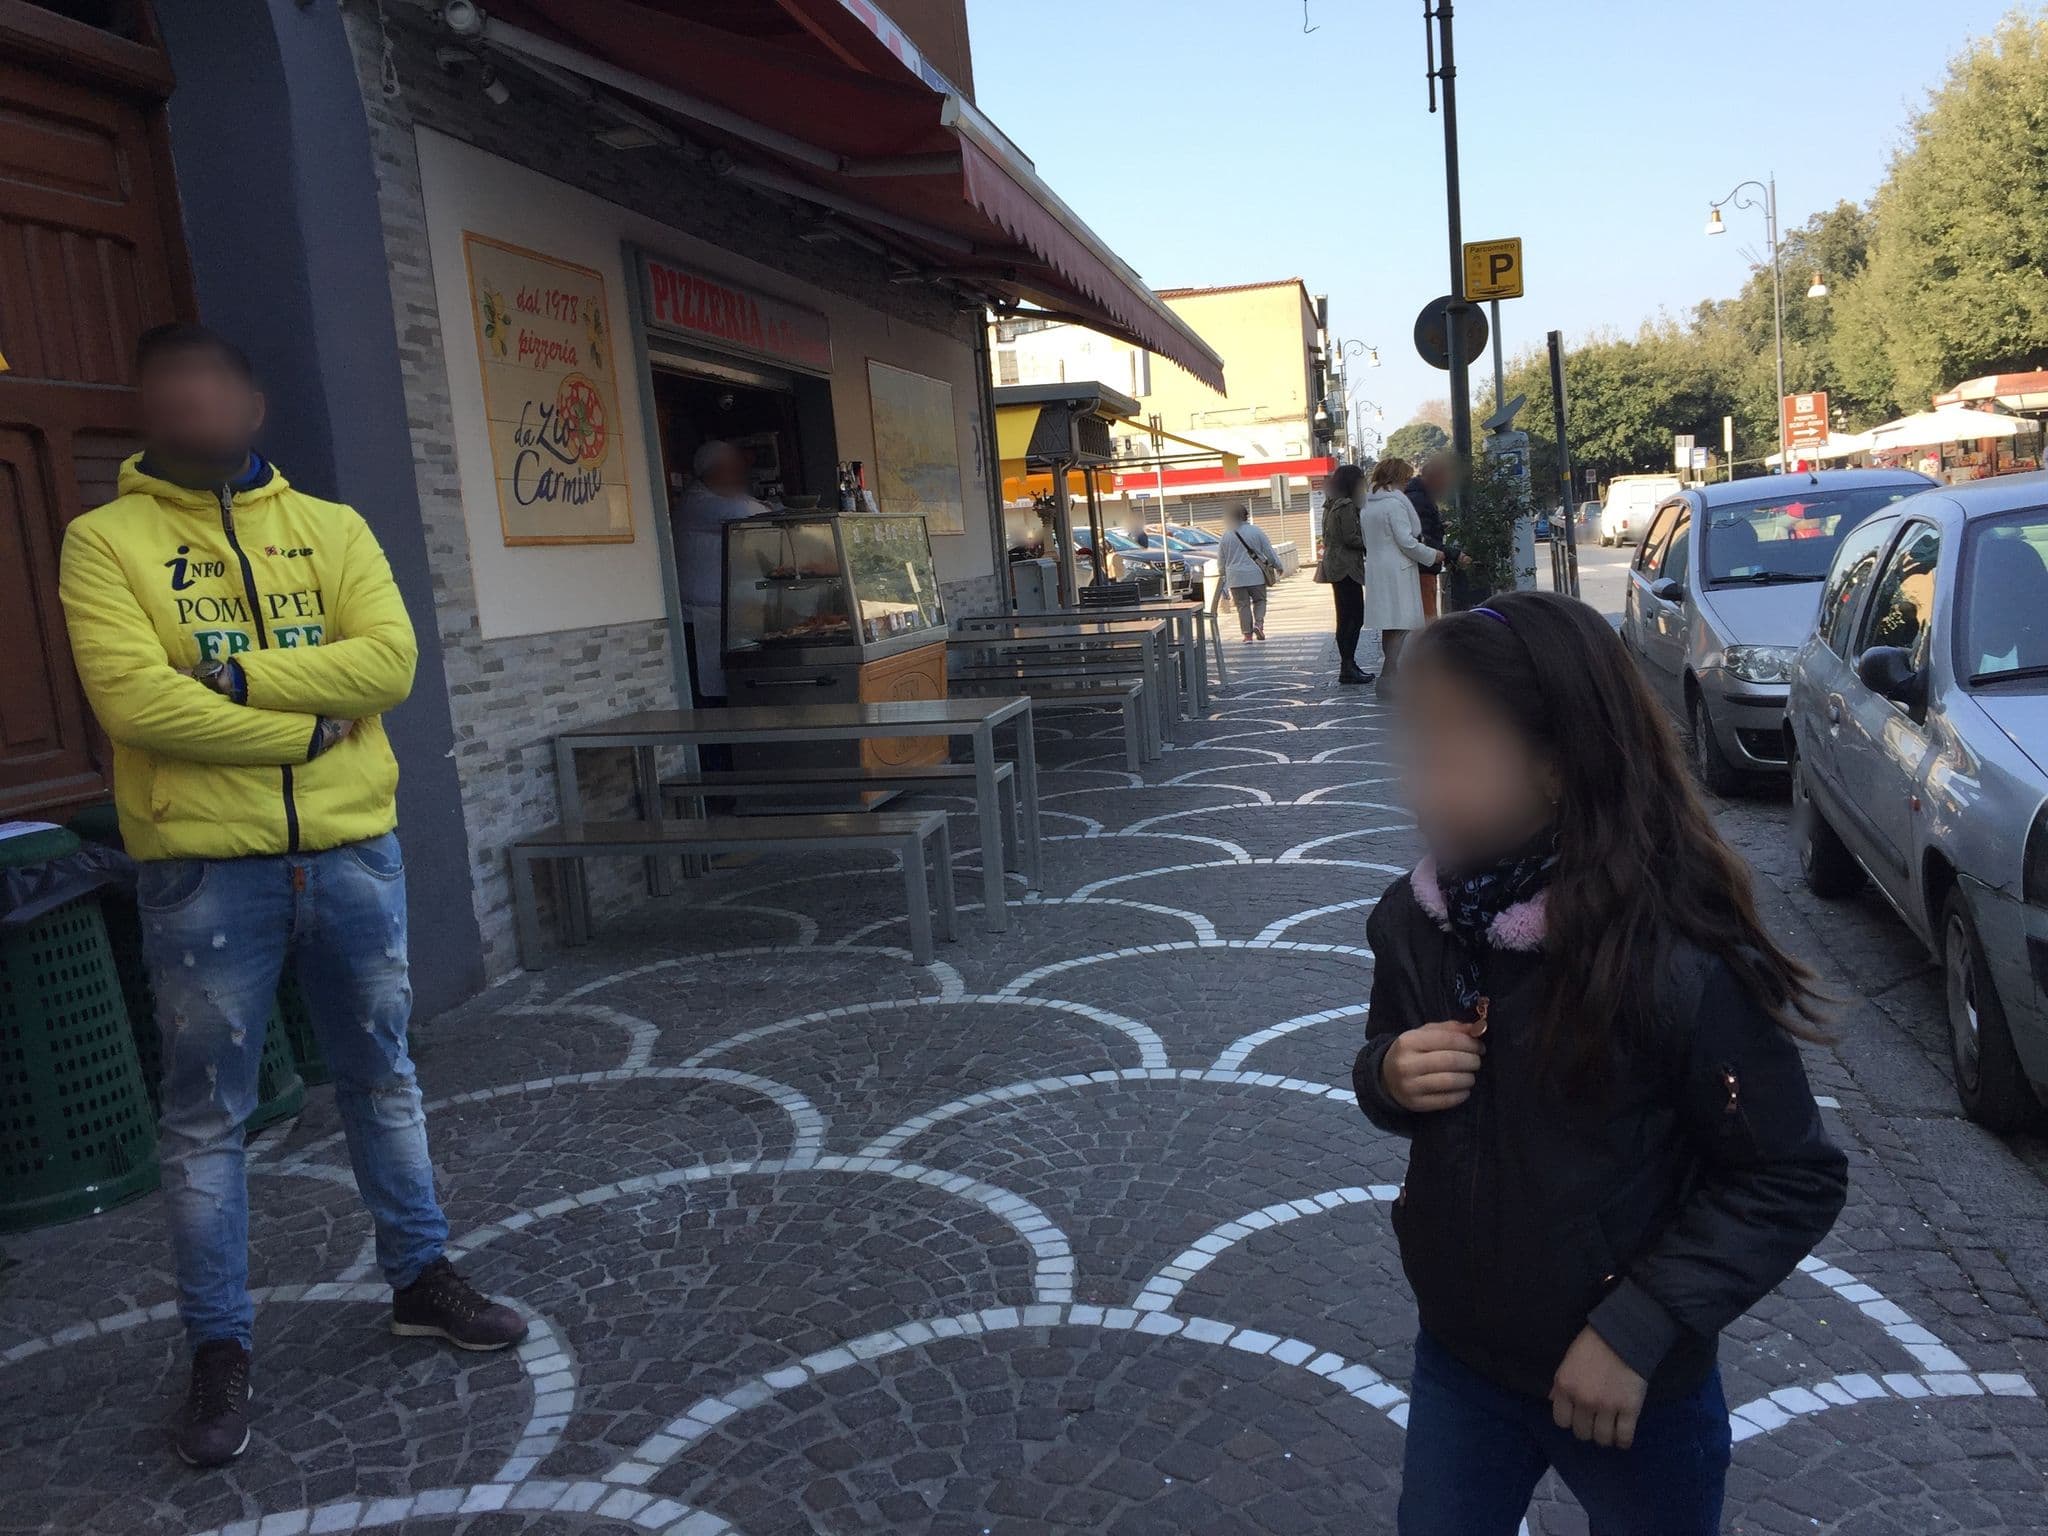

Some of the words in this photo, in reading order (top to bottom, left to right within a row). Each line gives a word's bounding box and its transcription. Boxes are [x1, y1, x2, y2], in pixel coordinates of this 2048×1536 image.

[1489, 253, 1514, 285] P
[517, 284, 541, 314] dal
[545, 289, 579, 324] 1978
[649, 262, 766, 350] PIZZERIA
[518, 328, 577, 369] pizzeria
[514, 401, 535, 447] da
[536, 402, 581, 465] Zio
[514, 449, 602, 506] Carmine
